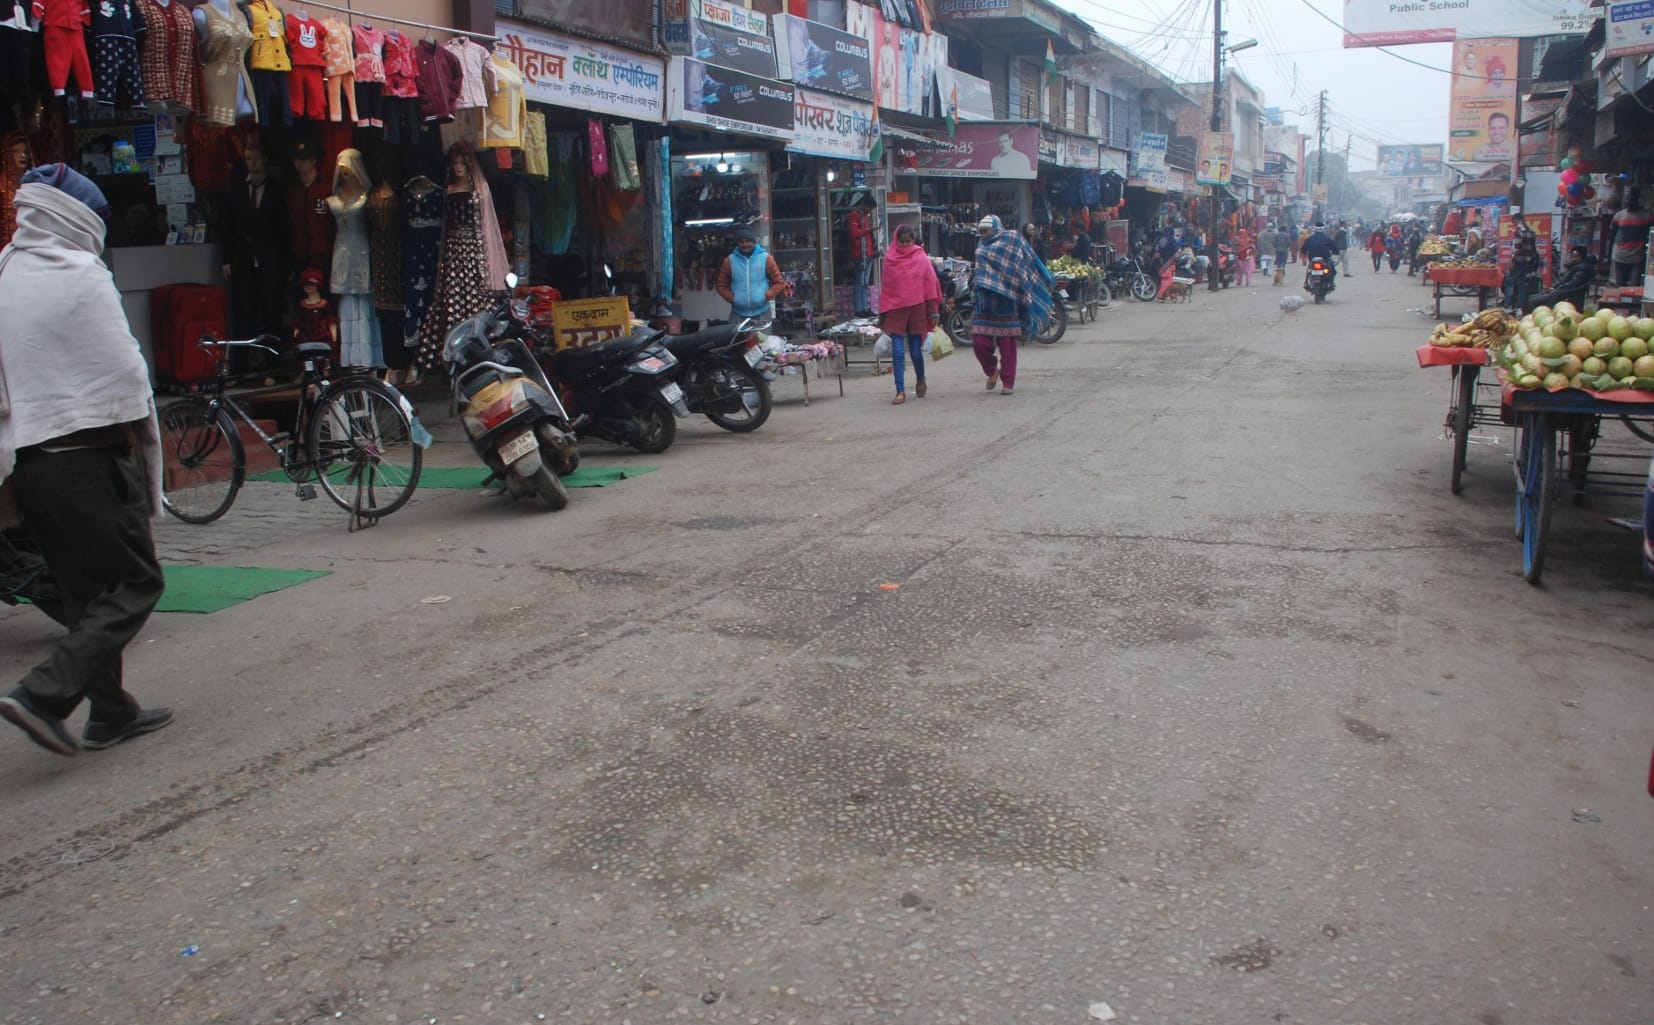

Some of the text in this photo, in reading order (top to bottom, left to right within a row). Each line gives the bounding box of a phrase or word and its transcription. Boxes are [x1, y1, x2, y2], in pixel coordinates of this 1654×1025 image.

[1390, 0, 1469, 12] Public School
[737, 36, 772, 54] COLUMBUS
[835, 40, 868, 59] COLUMBUS
[759, 85, 793, 102] COLUMBUS
